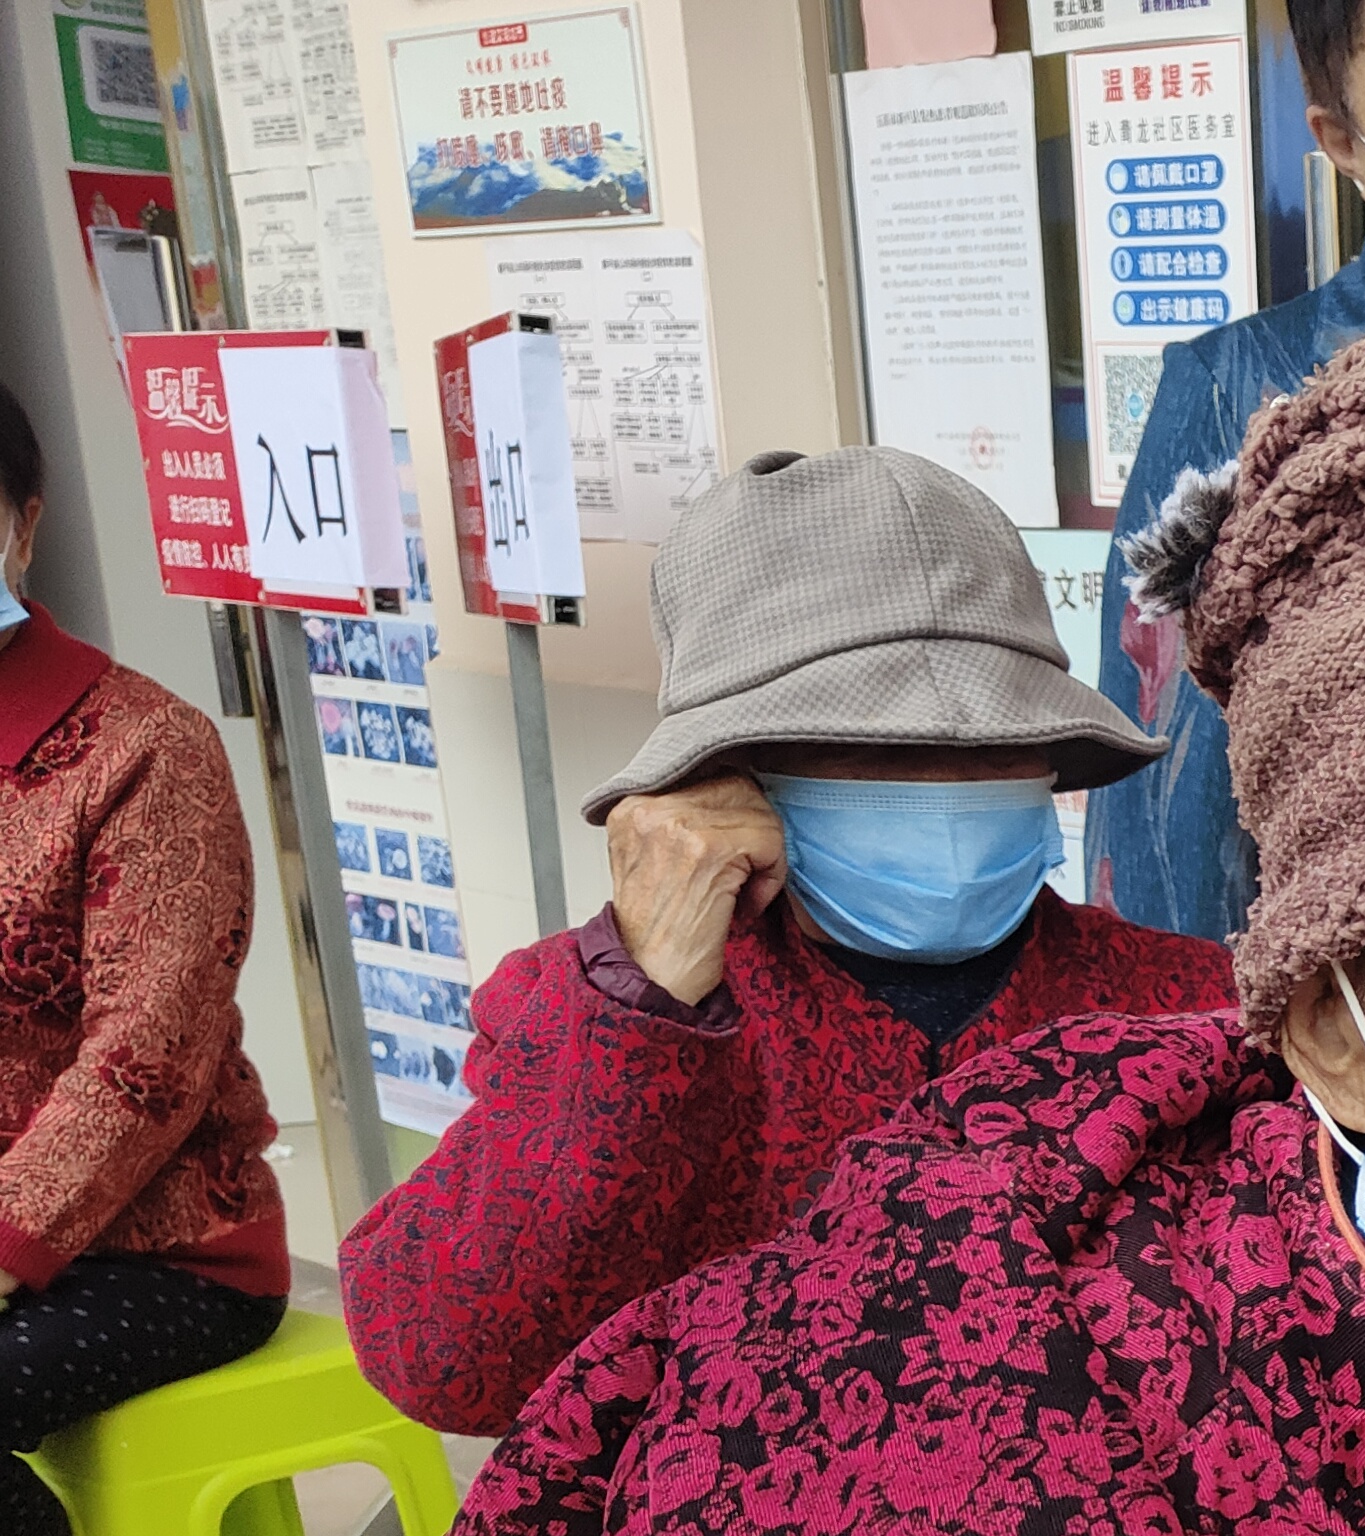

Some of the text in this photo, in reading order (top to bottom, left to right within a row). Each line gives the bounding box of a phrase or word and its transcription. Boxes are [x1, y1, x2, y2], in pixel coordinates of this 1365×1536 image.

[1103, 61, 1213, 103] 温馨提示
[1133, 159, 1218, 189] 请佩戴口罩
[1136, 204, 1221, 232] 请测量体温
[1138, 249, 1222, 277] 请配合检查
[1140, 295, 1225, 323] 出示健康码
[146, 367, 229, 424] 温馨提示
[257, 434, 346, 543] 入口
[486, 428, 530, 558] 出口
